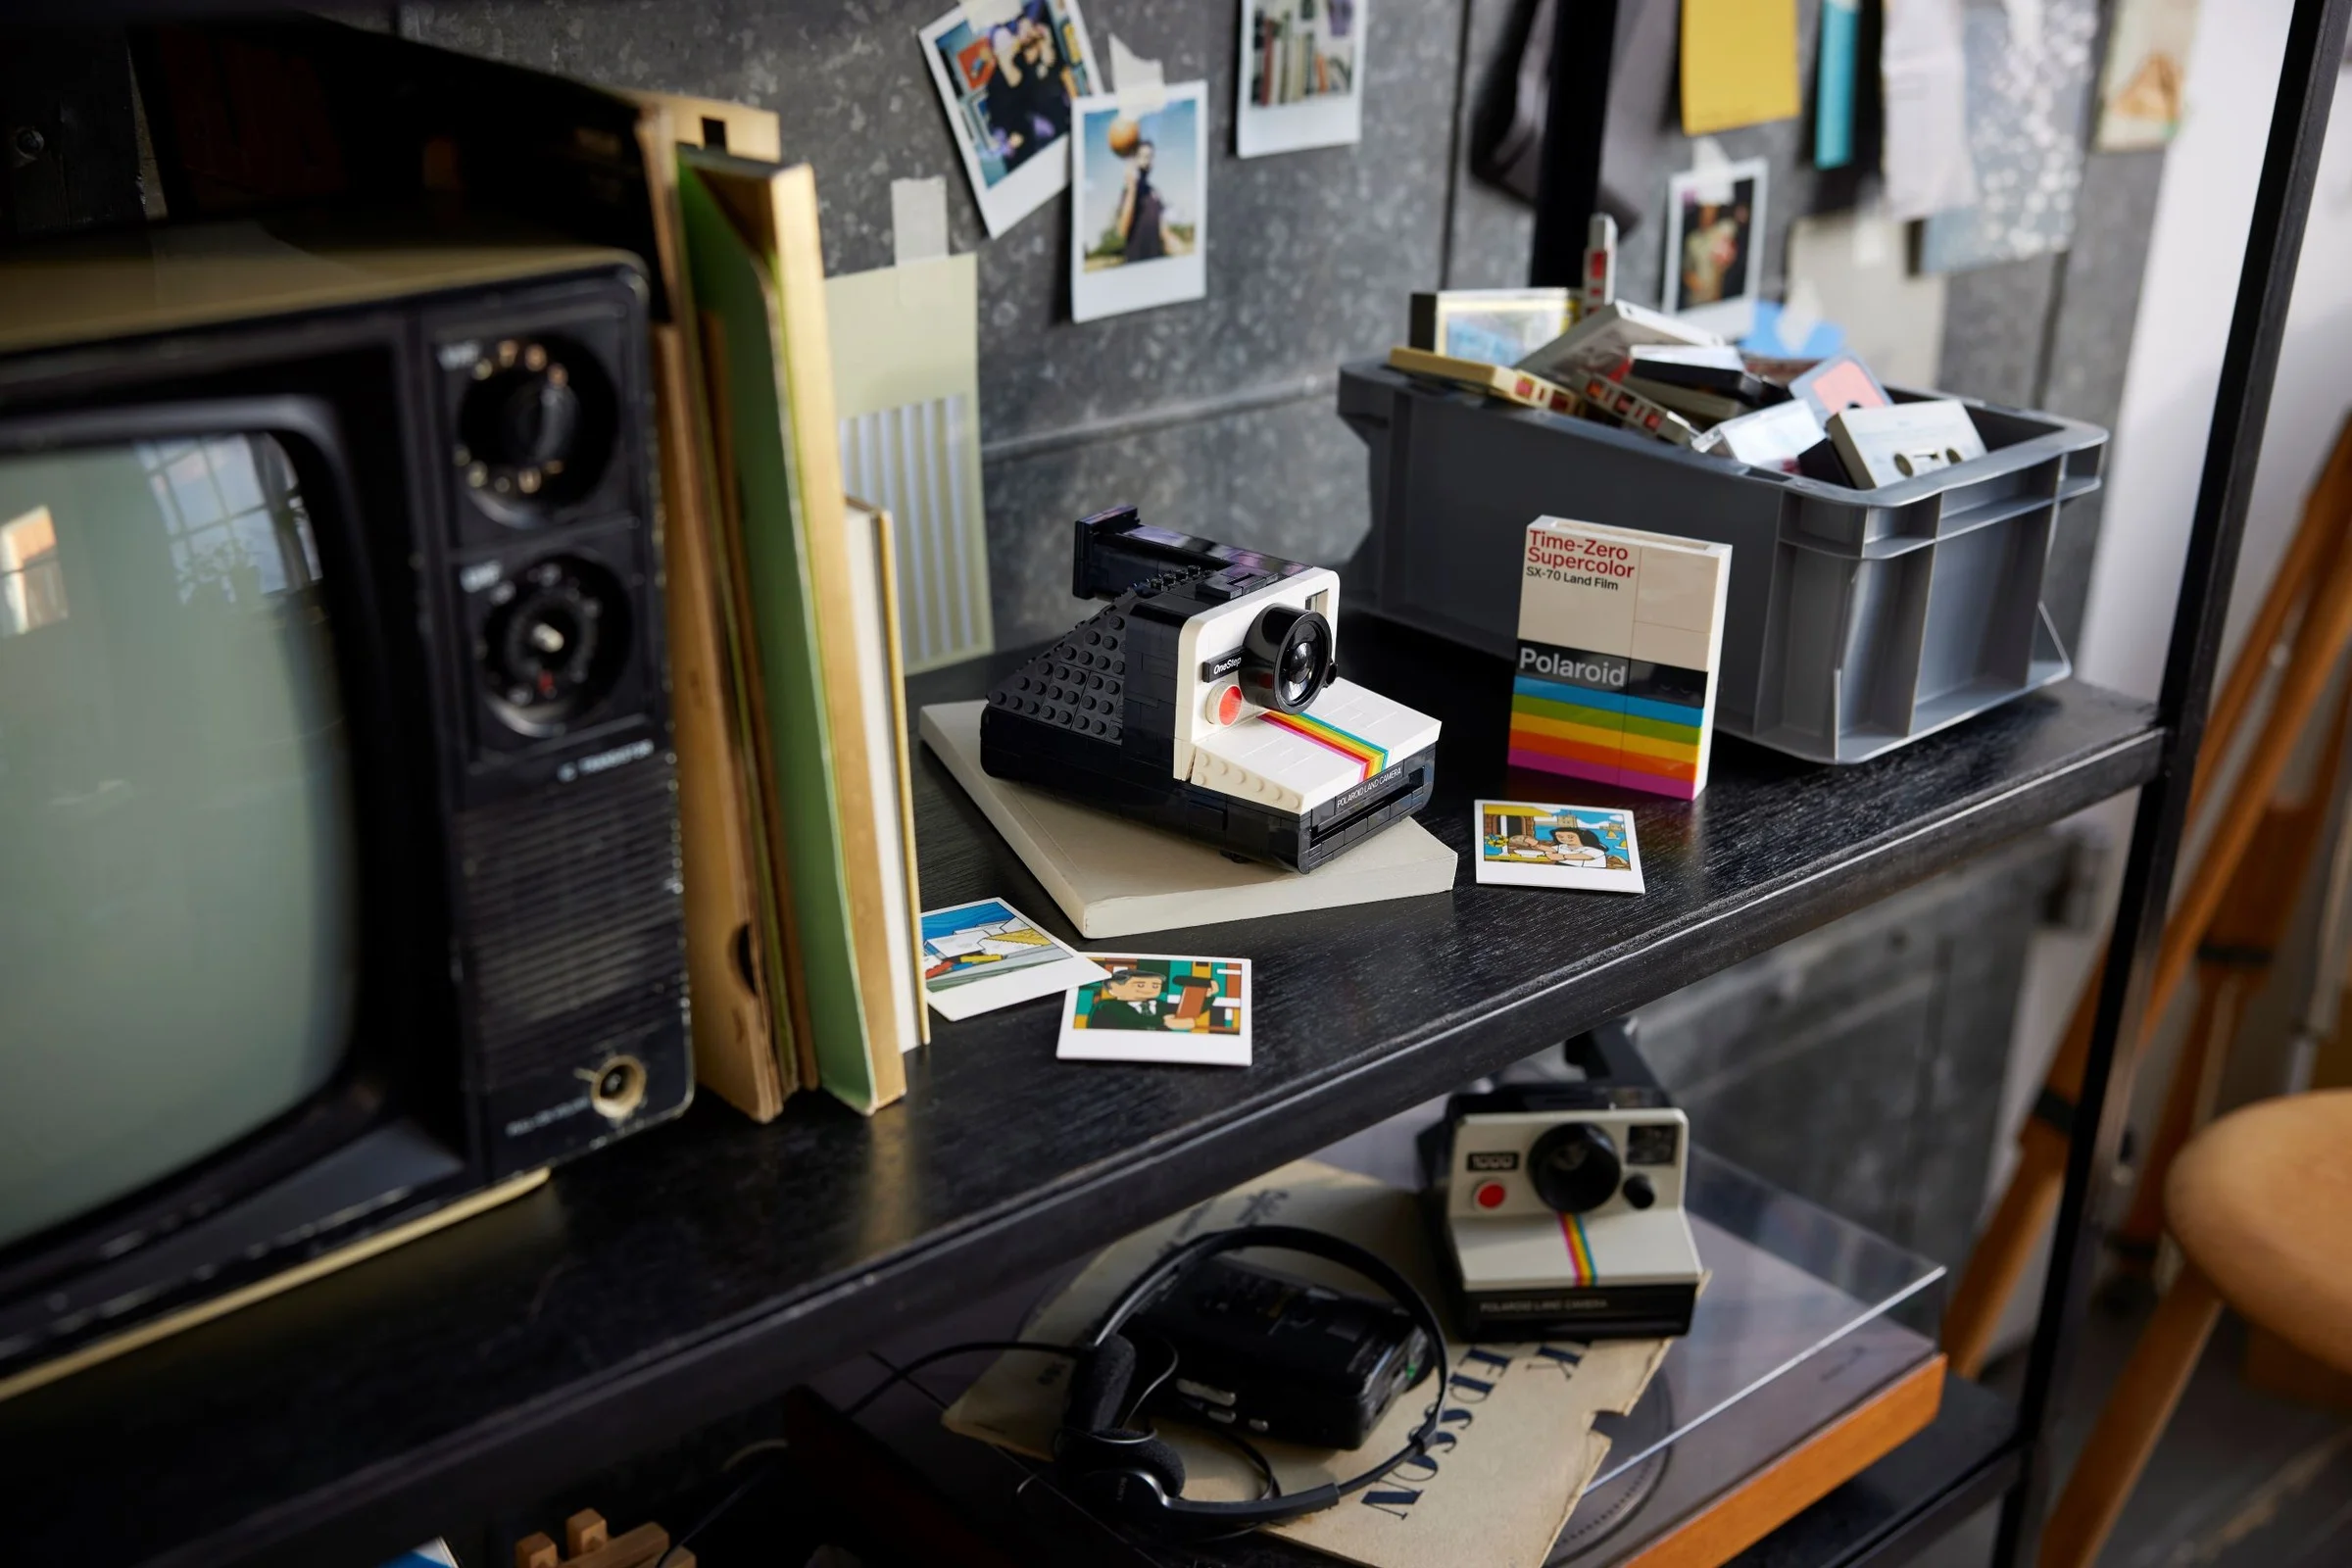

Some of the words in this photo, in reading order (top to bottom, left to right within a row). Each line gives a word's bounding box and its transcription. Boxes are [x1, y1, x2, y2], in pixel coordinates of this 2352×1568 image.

[1529, 530, 1629, 561] Time-Zero
[1527, 547, 1635, 578] Supercolor
[1526, 566, 1561, 581] SX-70
[1563, 572, 1592, 586] Land
[1593, 577, 1619, 591] Film
[1213, 657, 1242, 675] OneStep
[1519, 647, 1627, 687] Polaroid
[1337, 786, 1364, 808] POLAROID
[1363, 779, 1379, 793] LAND
[1379, 767, 1401, 785] CAMERA
